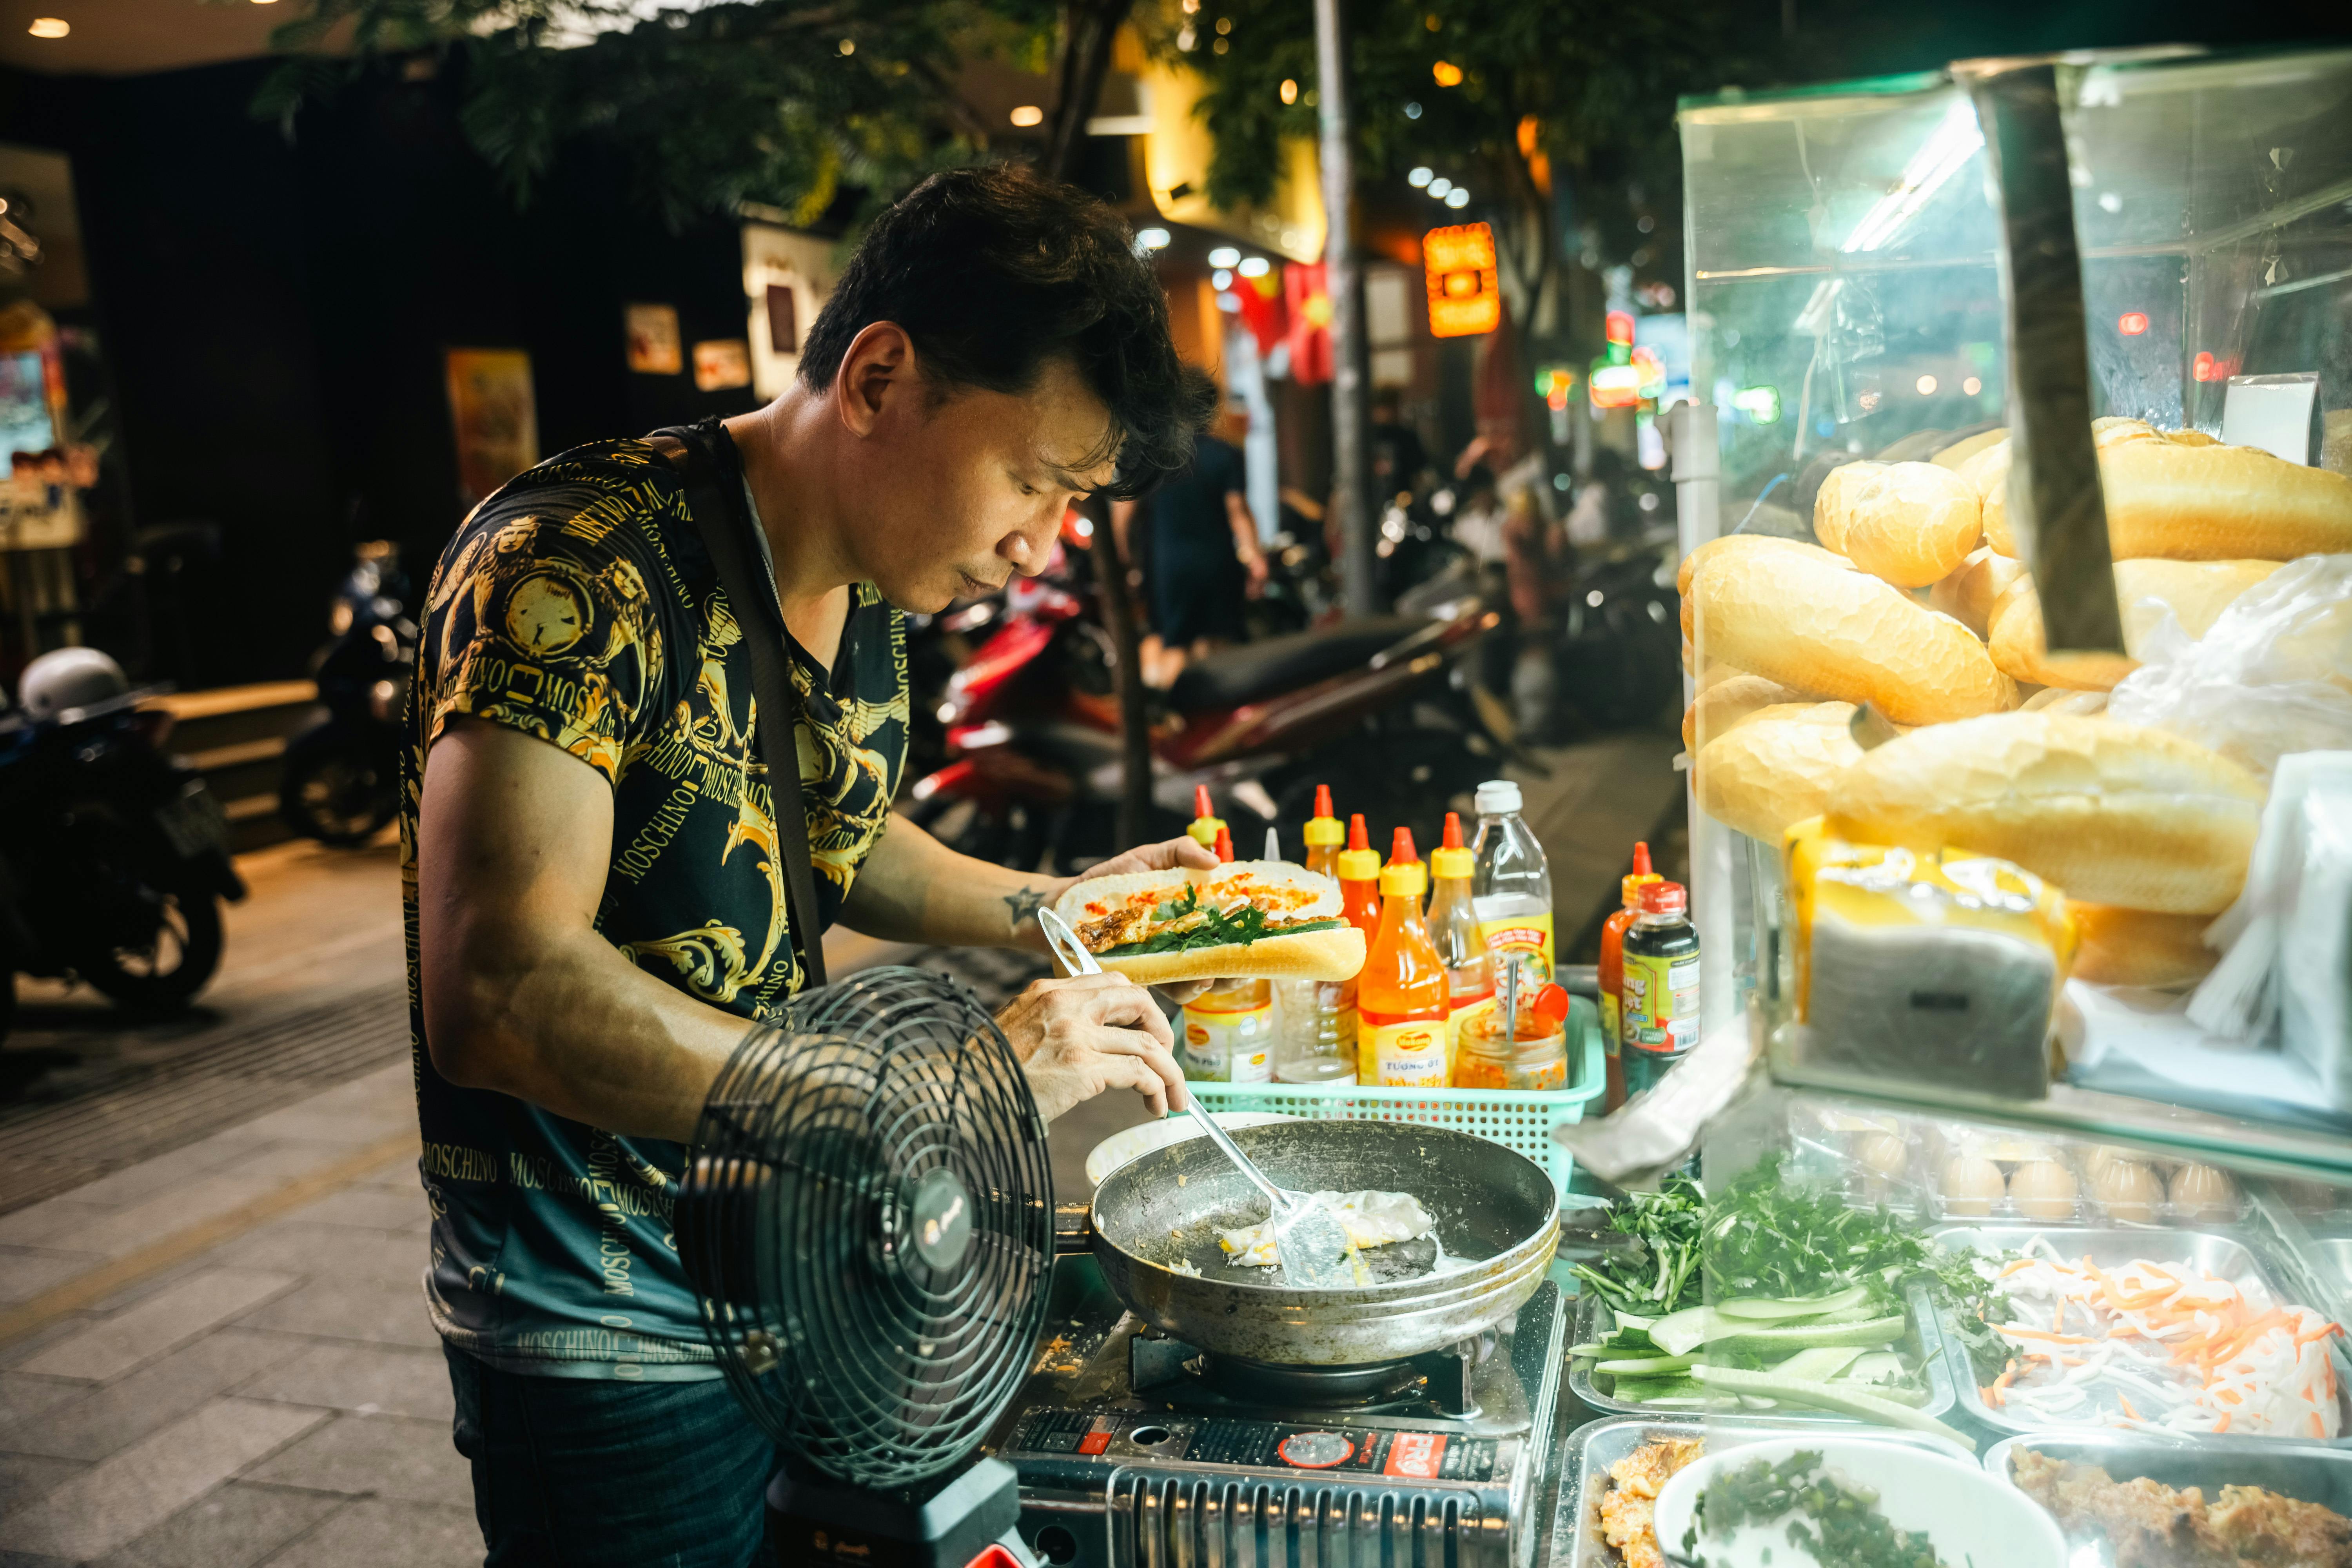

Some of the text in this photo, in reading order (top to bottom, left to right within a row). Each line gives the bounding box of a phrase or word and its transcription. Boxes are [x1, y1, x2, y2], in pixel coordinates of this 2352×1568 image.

[613, 789, 696, 885] MOSCHINO
[423, 1140, 497, 1183] MOSCHINO
[517, 1329, 611, 1362] MOSCHINO
